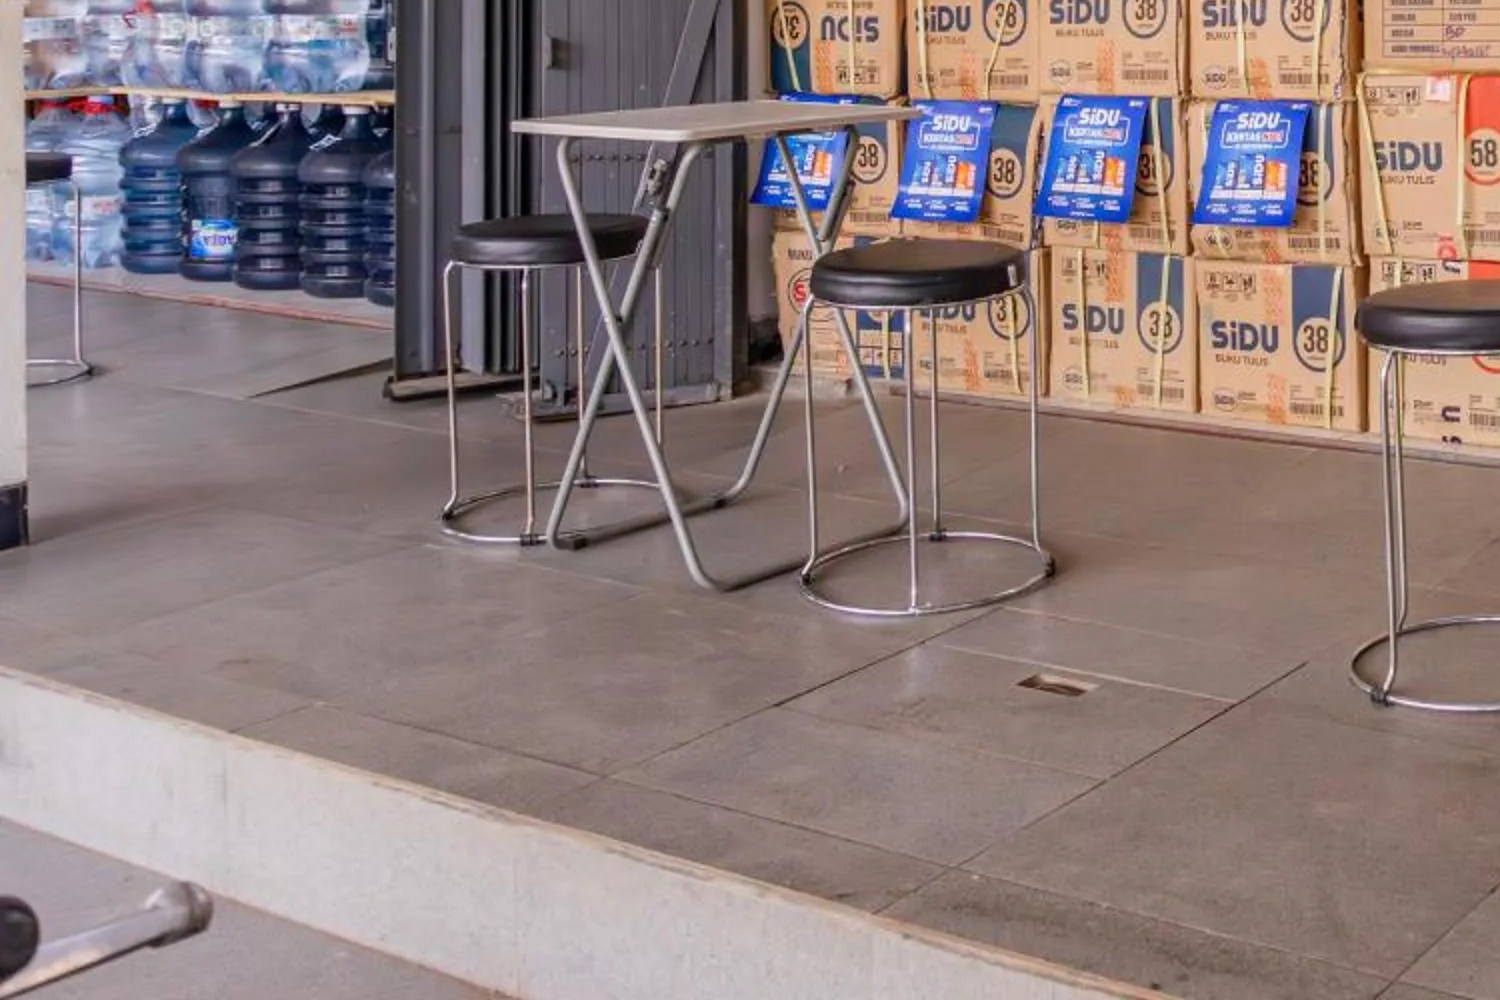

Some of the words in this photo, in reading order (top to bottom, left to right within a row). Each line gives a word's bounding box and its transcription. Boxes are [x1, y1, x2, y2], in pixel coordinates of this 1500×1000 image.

[995, 3, 1017, 28] 38
[932, 115, 970, 132] SiDU
[1078, 107, 1120, 127] SiDU
[1236, 112, 1280, 129] SiDU
[857, 143, 879, 168] 38
[1374, 141, 1443, 171] SiDU
[1471, 139, 1498, 167] 58
[994, 157, 1015, 184] 38
[1380, 174, 1405, 184] UKU
[1406, 174, 1436, 185] TULIS
[1062, 304, 1124, 334] SDU
[1149, 310, 1173, 338] 38
[1211, 320, 1279, 353] SiDU
[1303, 325, 1329, 353] 38
